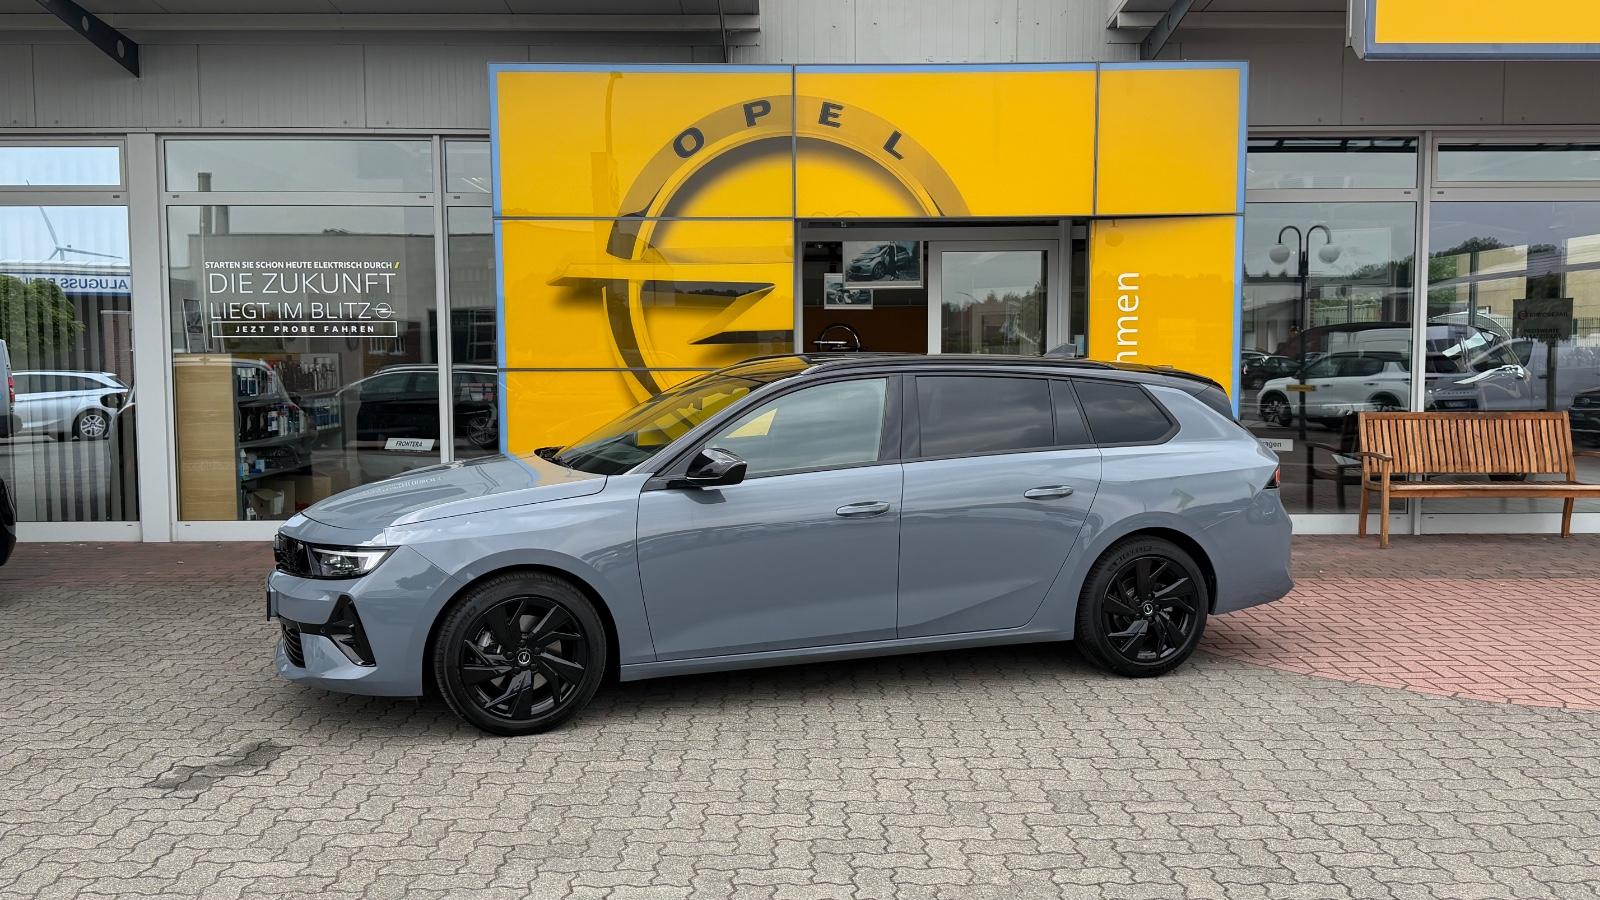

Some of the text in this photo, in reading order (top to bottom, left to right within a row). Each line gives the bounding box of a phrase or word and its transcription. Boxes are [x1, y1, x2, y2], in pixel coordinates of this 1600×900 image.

[672, 99, 904, 161] OPEL
[204, 261, 392, 269] STARTEN SIE SCHON HEUTE ELEKTRISCH DURCH
[209, 272, 397, 294] DIE ZUKUNFT
[210, 302, 371, 319] LIEGT IM BLITZ
[235, 325, 374, 333] JEZT PROBE FAHREN
[395, 440, 423, 448] FRONTERA
